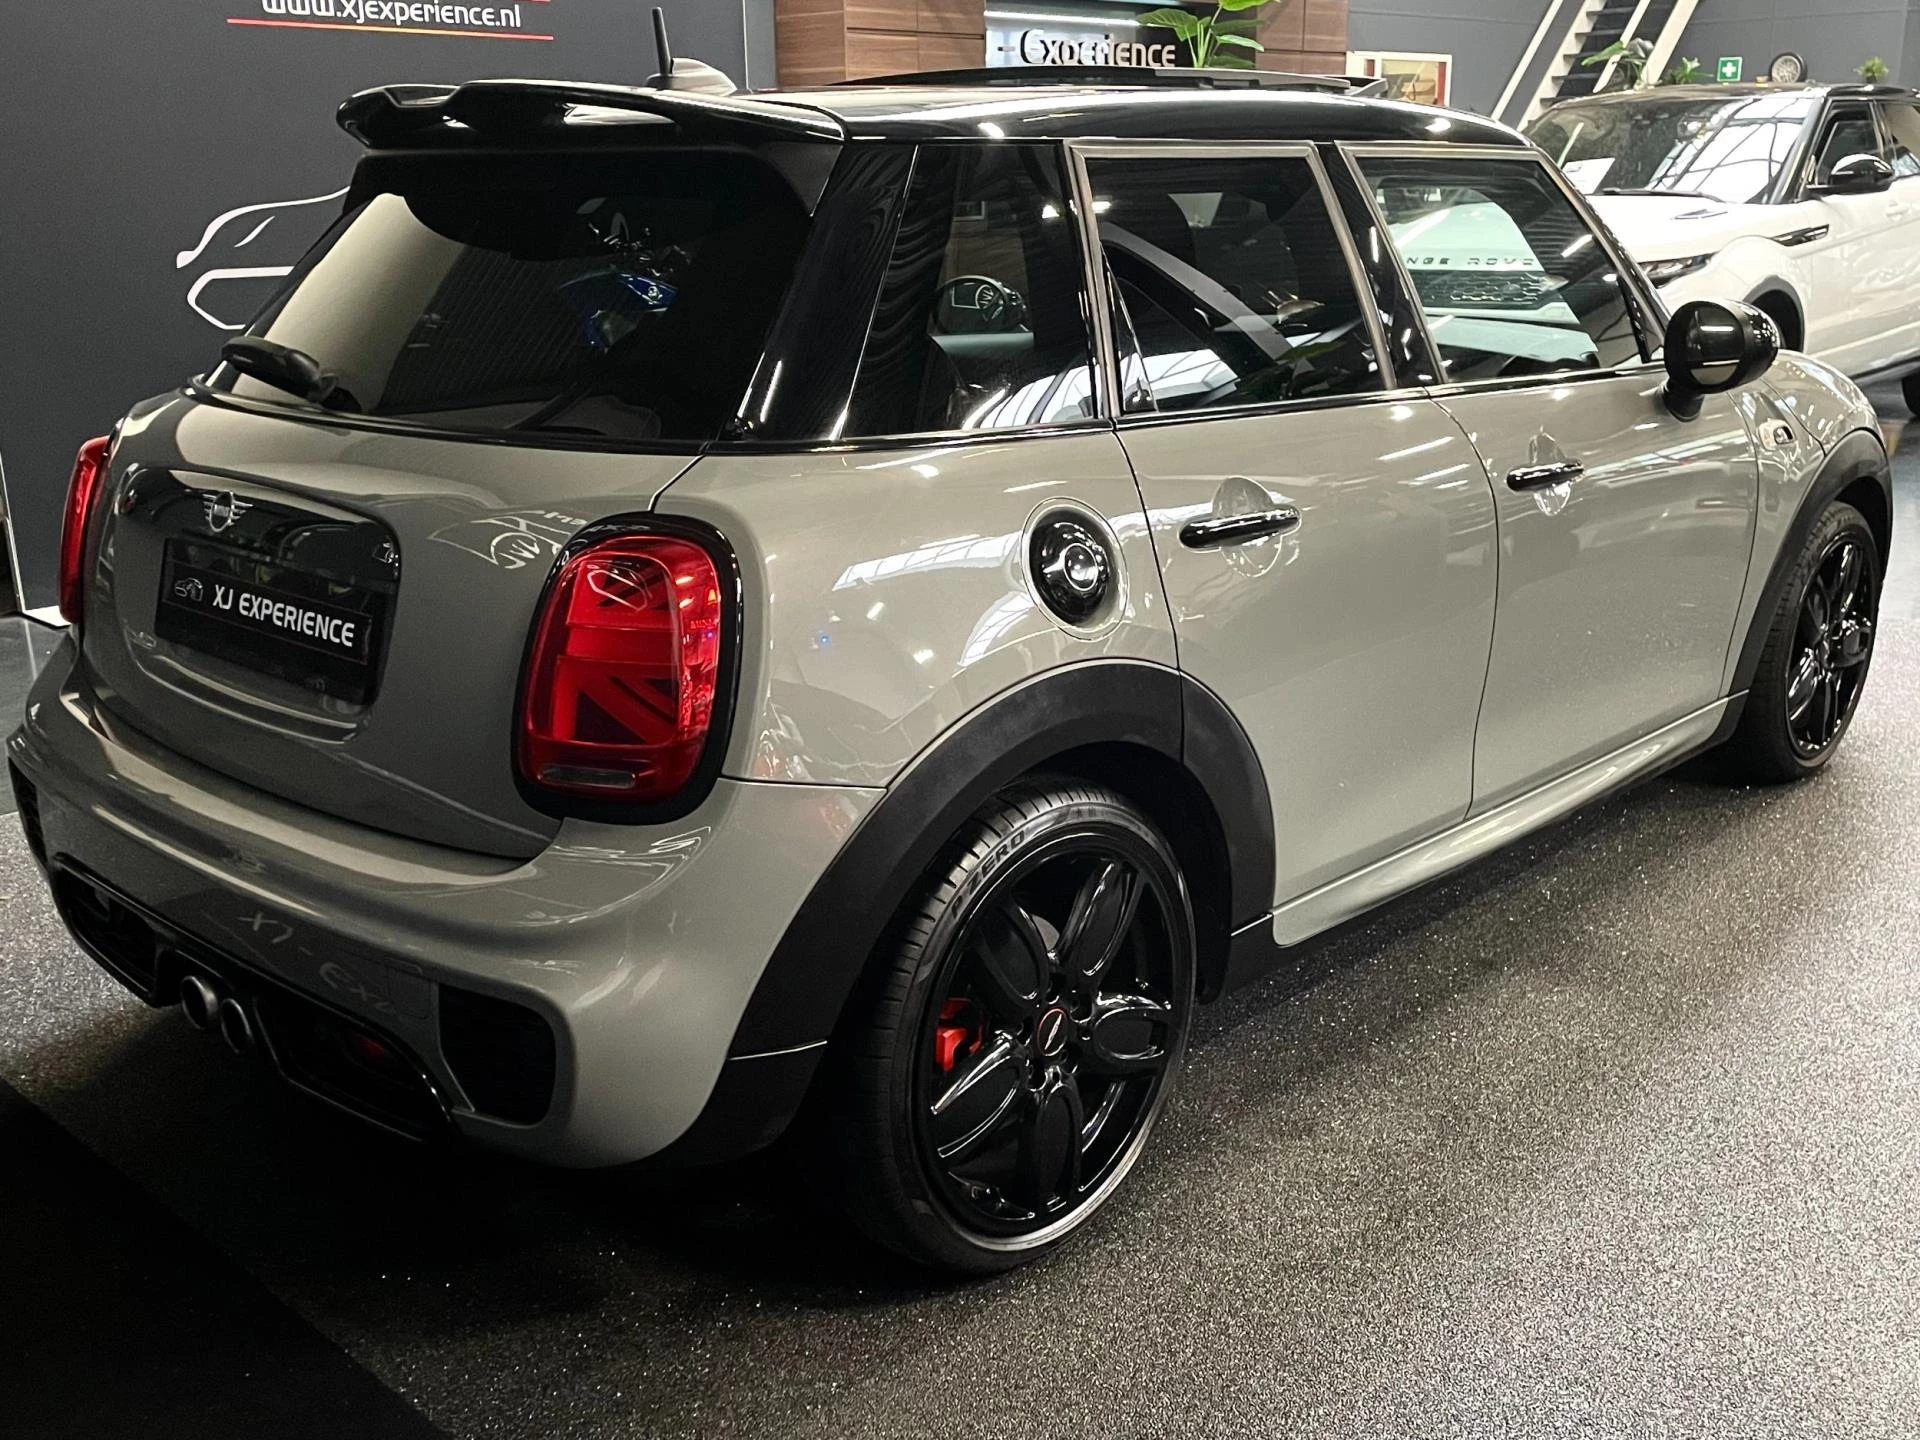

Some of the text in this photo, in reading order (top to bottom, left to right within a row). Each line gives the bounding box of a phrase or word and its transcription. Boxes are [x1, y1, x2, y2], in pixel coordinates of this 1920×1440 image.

[262, 0, 521, 27] www.xjexperience.nl
[1406, 256, 1535, 266] NGE ROVE
[212, 584, 356, 648] XJ EXPERIENCE
[951, 829, 1026, 919] P ZERO
